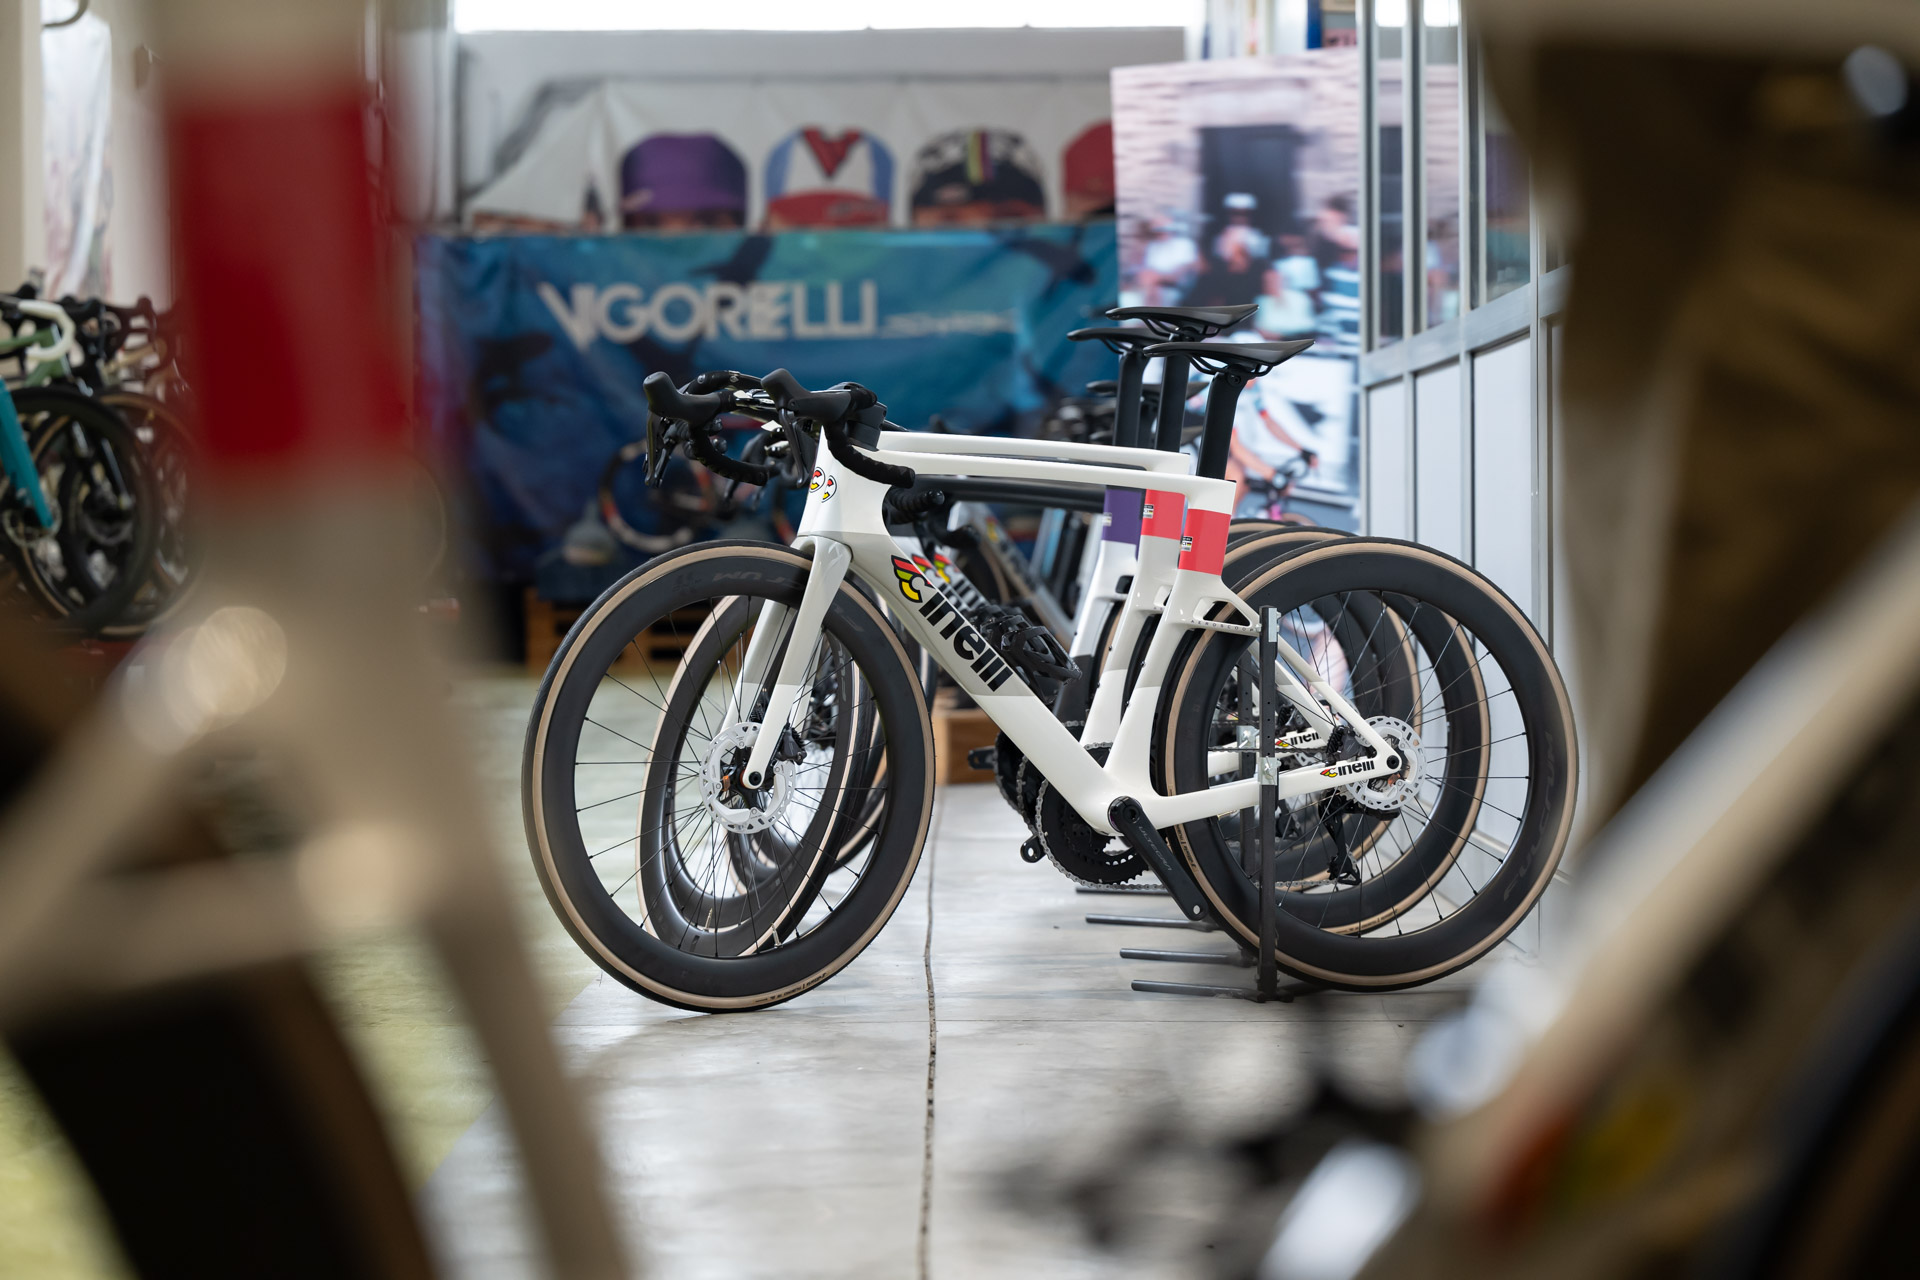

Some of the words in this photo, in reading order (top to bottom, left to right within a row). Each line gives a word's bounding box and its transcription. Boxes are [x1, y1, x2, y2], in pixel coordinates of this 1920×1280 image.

[538, 280, 878, 347] VIGORELLI
[891, 555, 1013, 692] Cinelli
[1190, 619, 1254, 632] AEROSCOOP
[1275, 732, 1321, 747] Cinell
[1319, 760, 1375, 778] Cinelli
[1138, 826, 1173, 871] ULTEGRA
